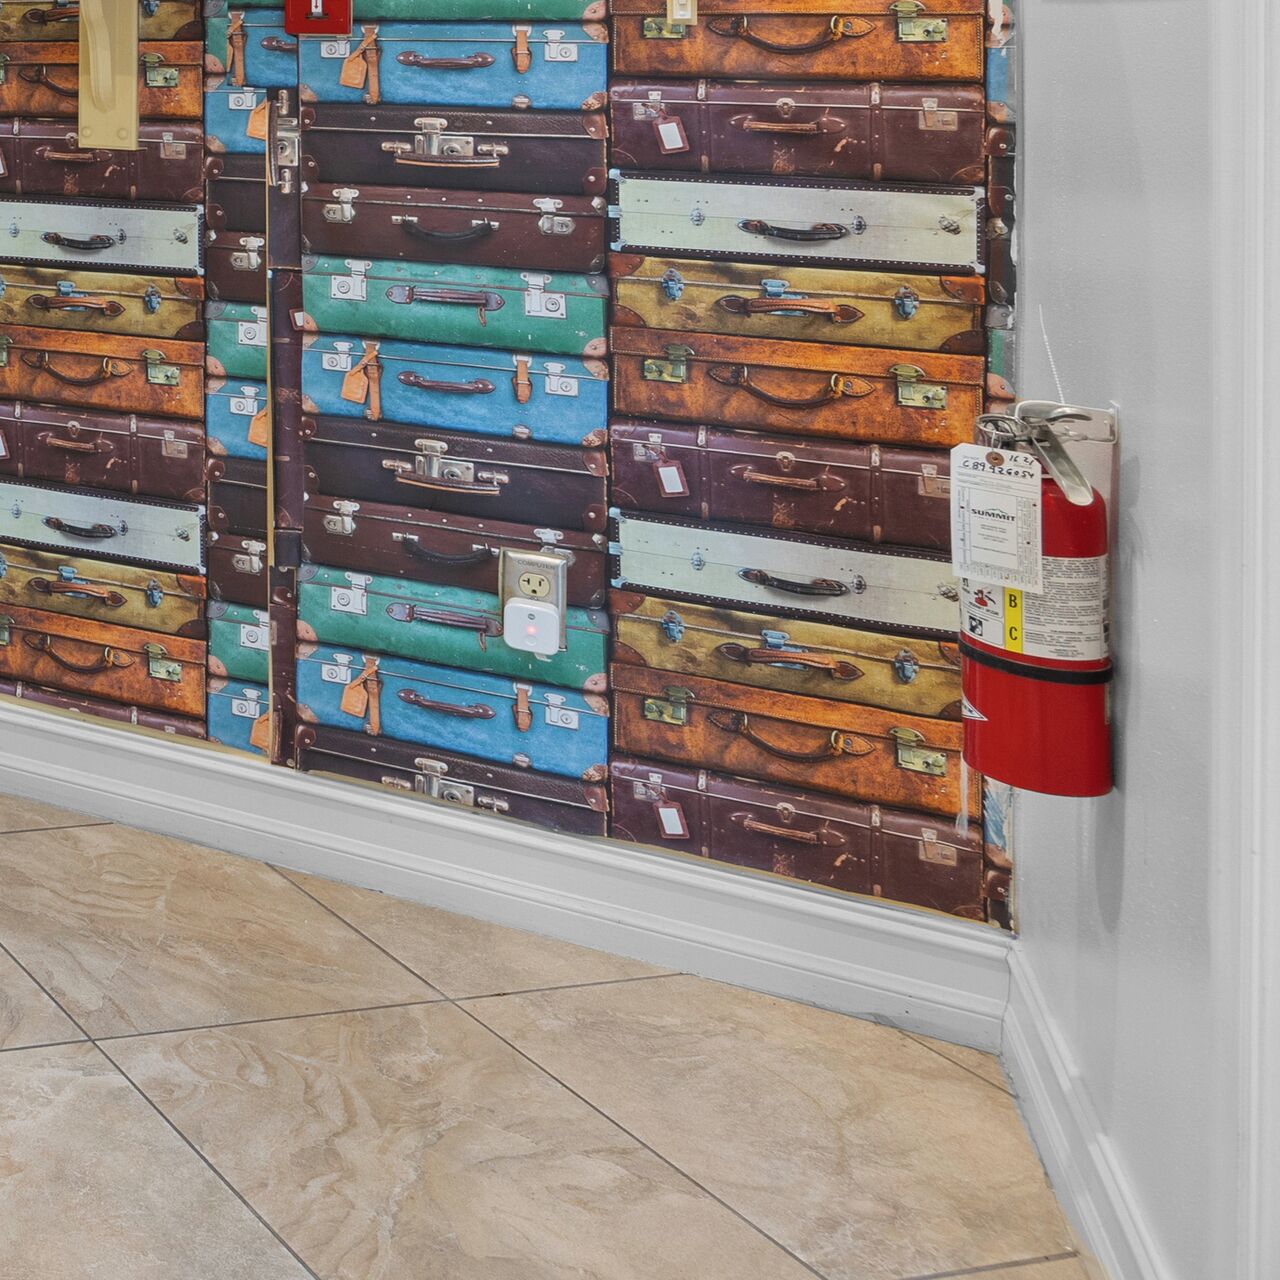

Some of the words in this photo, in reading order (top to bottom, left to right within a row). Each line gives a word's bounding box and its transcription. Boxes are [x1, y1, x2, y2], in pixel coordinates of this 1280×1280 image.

[971, 508, 1016, 522] SUMMIT
[1008, 593, 1018, 609] B
[1009, 626, 1018, 641] C
